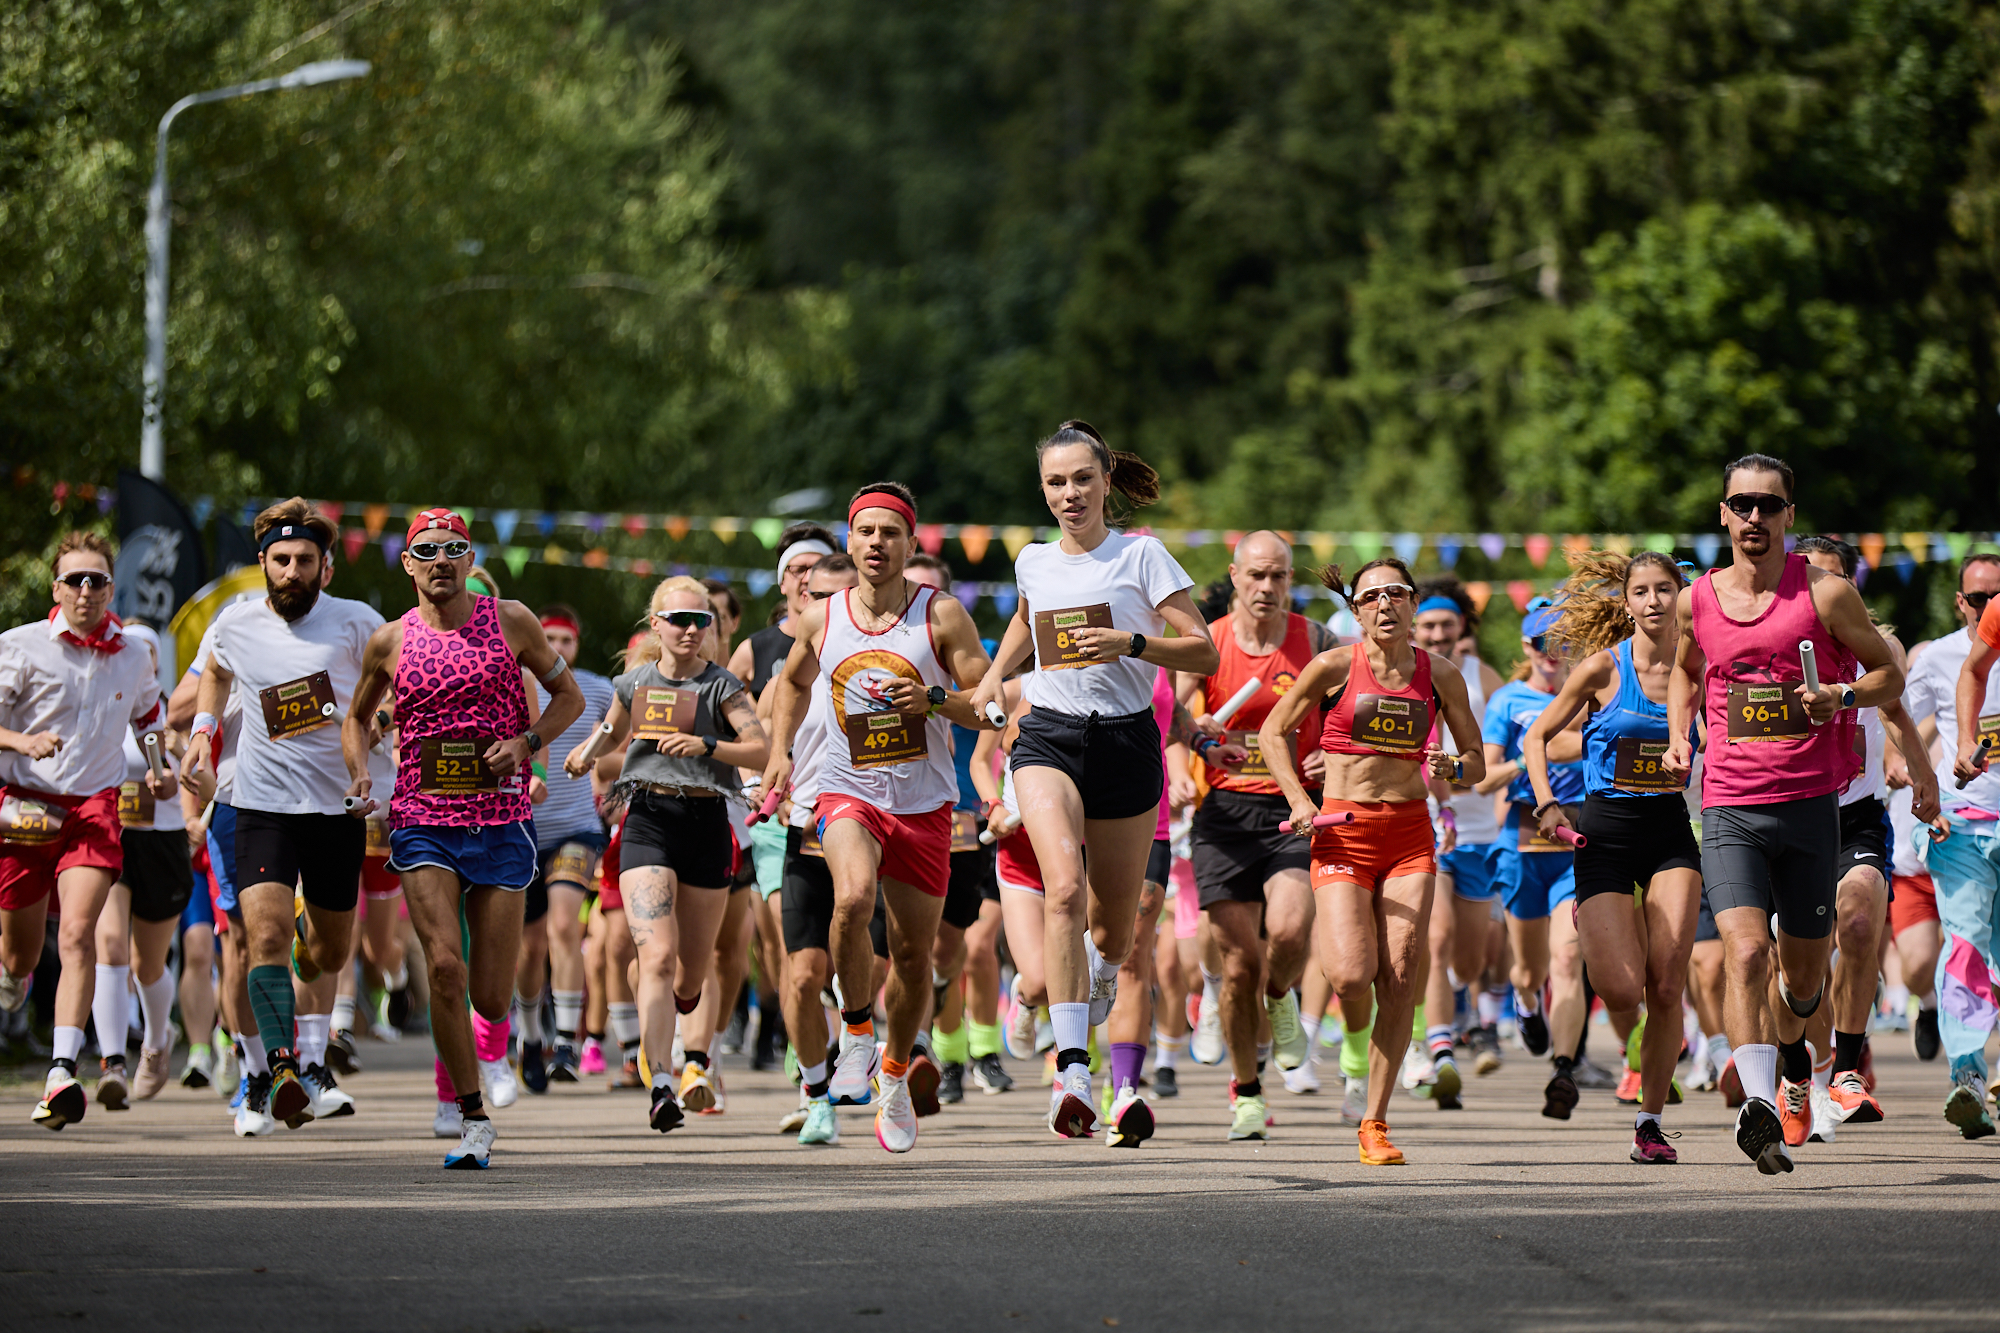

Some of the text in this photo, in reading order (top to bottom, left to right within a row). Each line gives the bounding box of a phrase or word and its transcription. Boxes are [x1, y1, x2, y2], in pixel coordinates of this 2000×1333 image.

[277, 695, 319, 720] 79-1
[645, 705, 673, 722] 6-1
[1742, 704, 1788, 722] 96-1
[1369, 716, 1413, 735] 40-1
[864, 729, 909, 749] 49-1
[436, 760, 479, 775] 52-1
[1318, 864, 1354, 877] INEOS
